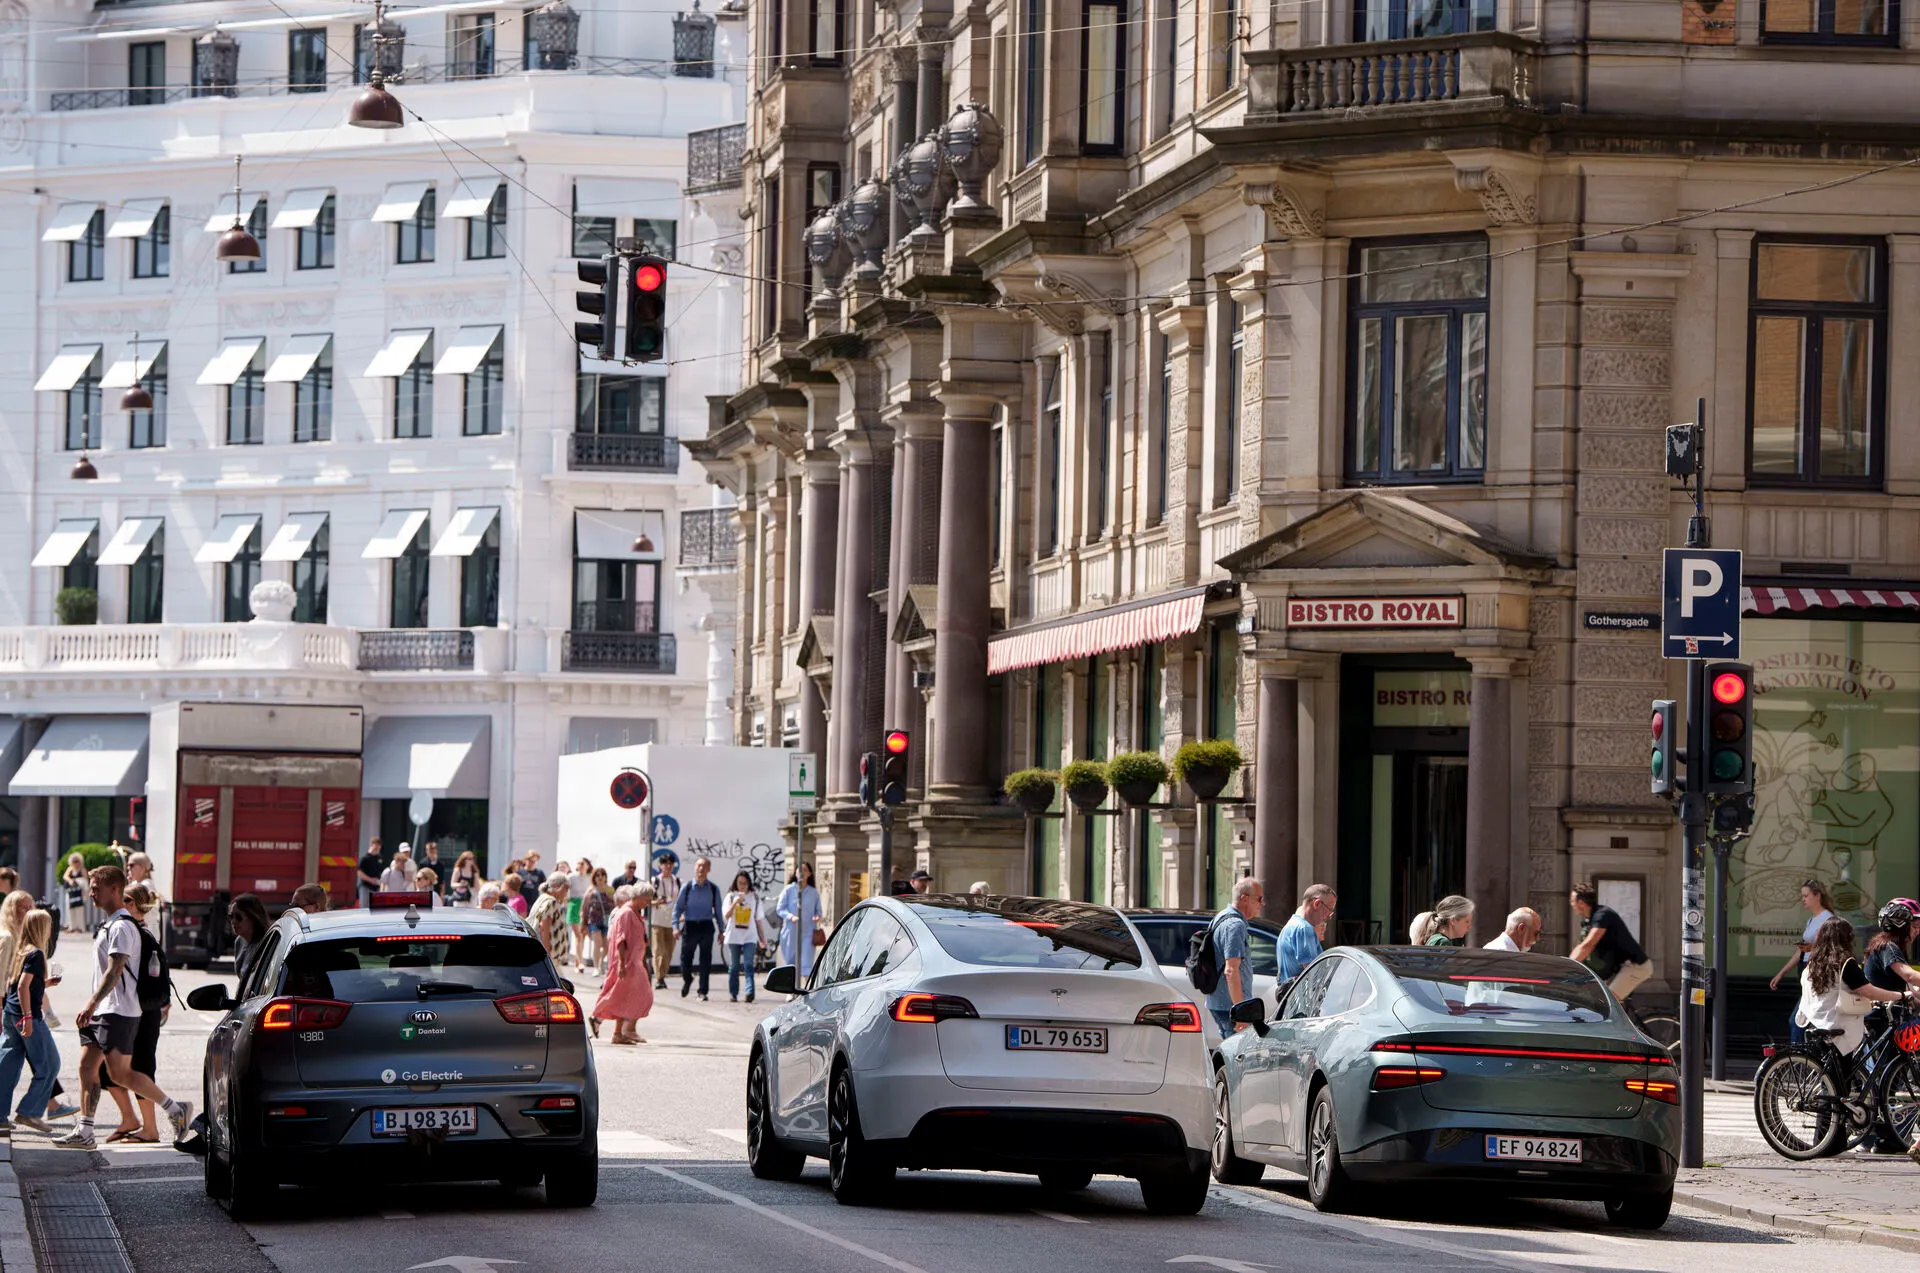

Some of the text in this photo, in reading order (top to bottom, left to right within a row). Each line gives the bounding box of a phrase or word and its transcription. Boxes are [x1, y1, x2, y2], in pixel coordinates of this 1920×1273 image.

[1681, 559, 1723, 618] P
[1291, 602, 1455, 622] BISTRO ROYAL
[1588, 615, 1649, 628] Gothersgade
[1752, 652, 1896, 691] OSED DUE TO
[1376, 690, 1447, 706] BISTRO
[414, 1012, 433, 1022] KIA
[300, 1031, 324, 1042] 4380
[402, 1027, 446, 1037] T Dantaxi
[1021, 1029, 1043, 1045] DL
[1048, 1030, 1069, 1047] 79
[1072, 1031, 1103, 1048] 653
[402, 1070, 463, 1081] Go Electric
[414, 1110, 437, 1128] 98
[440, 1109, 471, 1127] 361
[1499, 1139, 1520, 1155] EF
[1524, 1141, 1545, 1157] 94
[1548, 1142, 1579, 1159] 824
